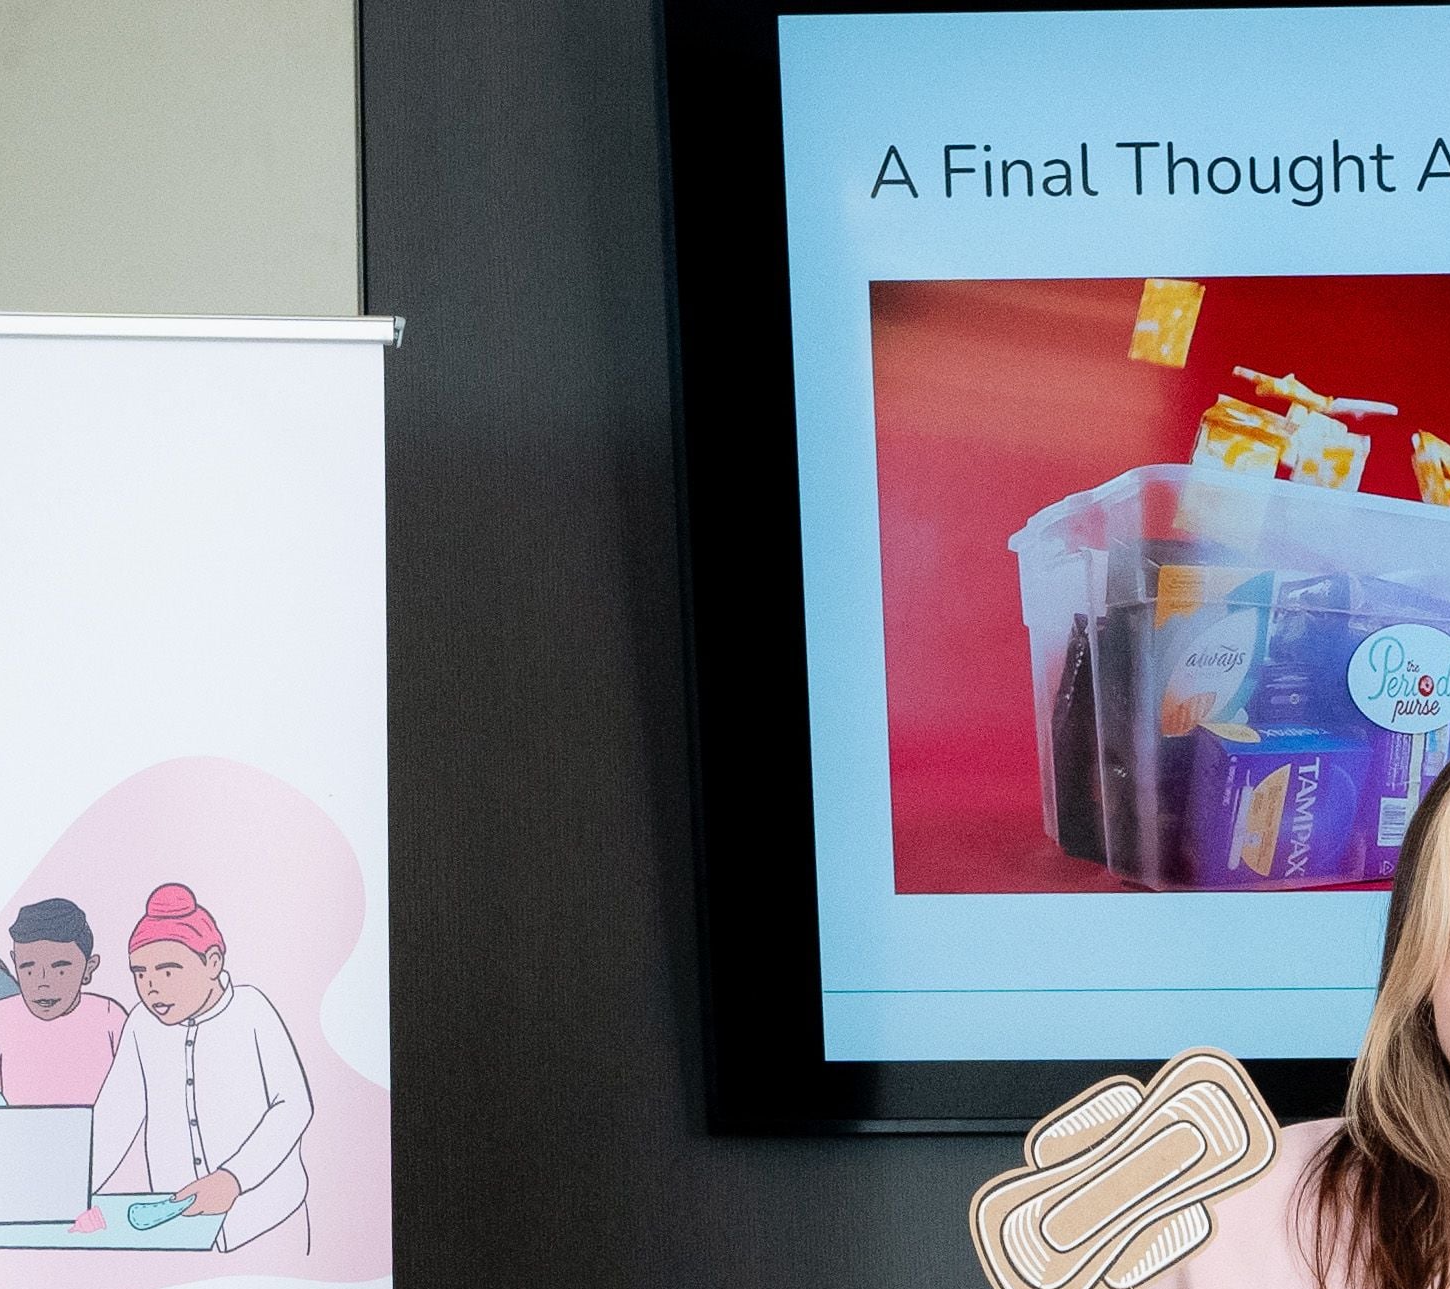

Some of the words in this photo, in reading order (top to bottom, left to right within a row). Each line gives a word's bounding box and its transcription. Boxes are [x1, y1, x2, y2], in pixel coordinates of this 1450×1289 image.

[871, 145, 918, 198] A
[944, 143, 1098, 198] Final
[1116, 139, 1396, 207] Thought
[1186, 645, 1246, 673] always
[1391, 699, 1441, 723] purse
[1285, 756, 1320, 877] TAMPAX
